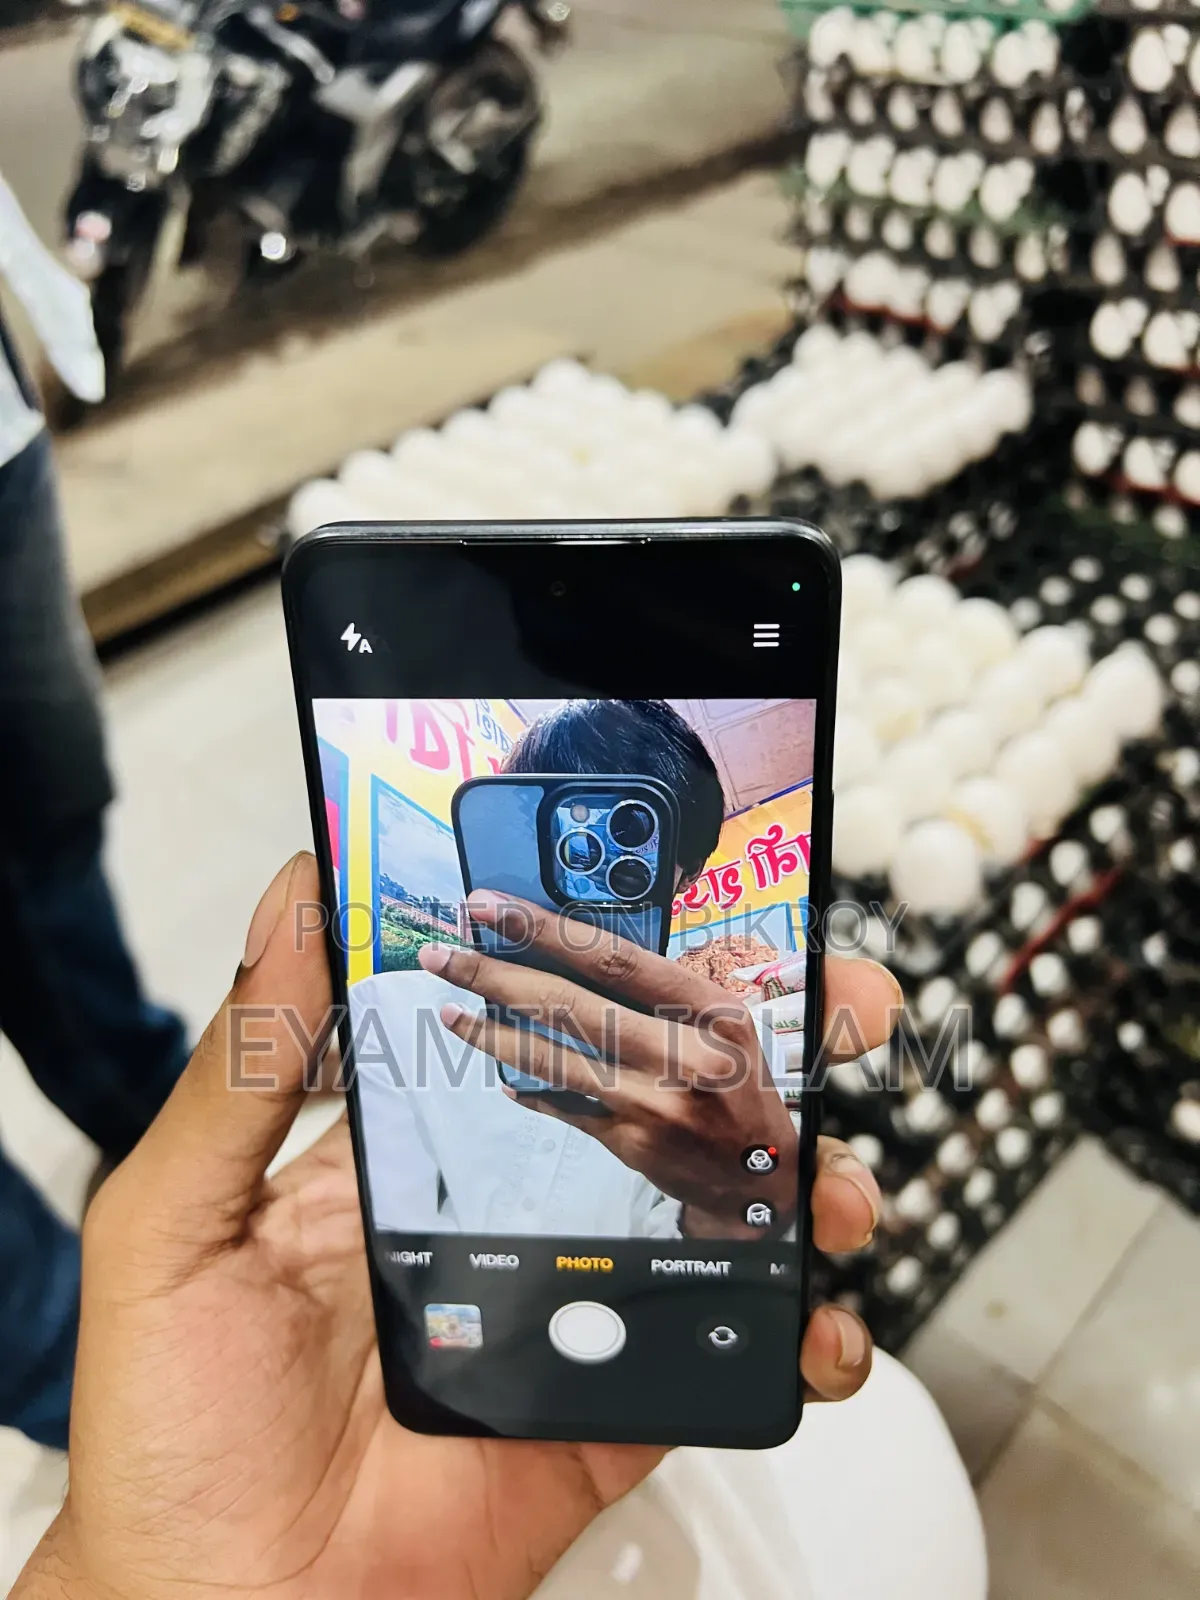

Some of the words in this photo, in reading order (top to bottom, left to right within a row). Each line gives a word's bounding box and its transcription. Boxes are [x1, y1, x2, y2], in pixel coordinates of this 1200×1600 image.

[469, 1253, 520, 1270] VIDEO
[555, 1256, 614, 1272] PHOTO
[651, 1259, 732, 1276] PORTRAIT
